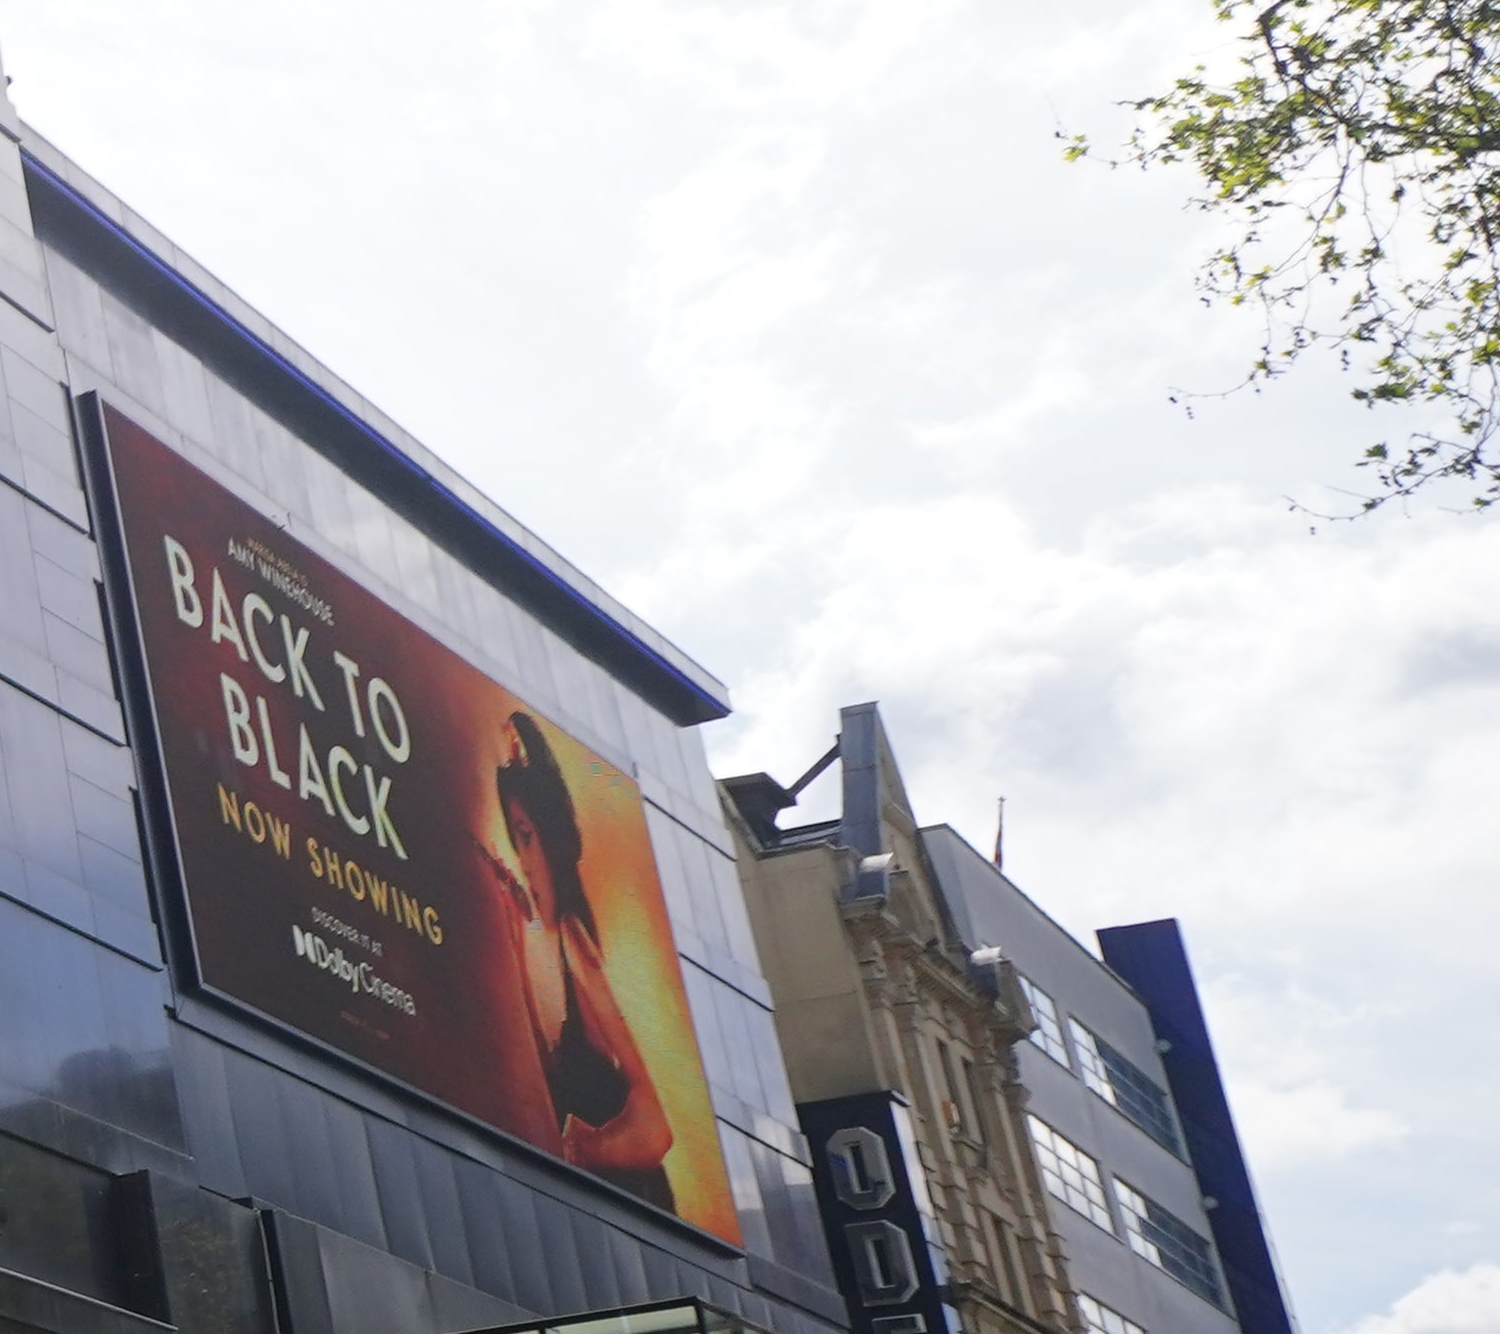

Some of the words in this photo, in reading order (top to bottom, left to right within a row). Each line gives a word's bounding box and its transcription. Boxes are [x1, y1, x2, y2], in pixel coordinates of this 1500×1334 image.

[162, 534, 325, 712] BACK
[333, 650, 412, 764] TO
[219, 671, 410, 861] BLACK
[217, 782, 293, 861] NOW
[308, 835, 444, 947] SHOWING
